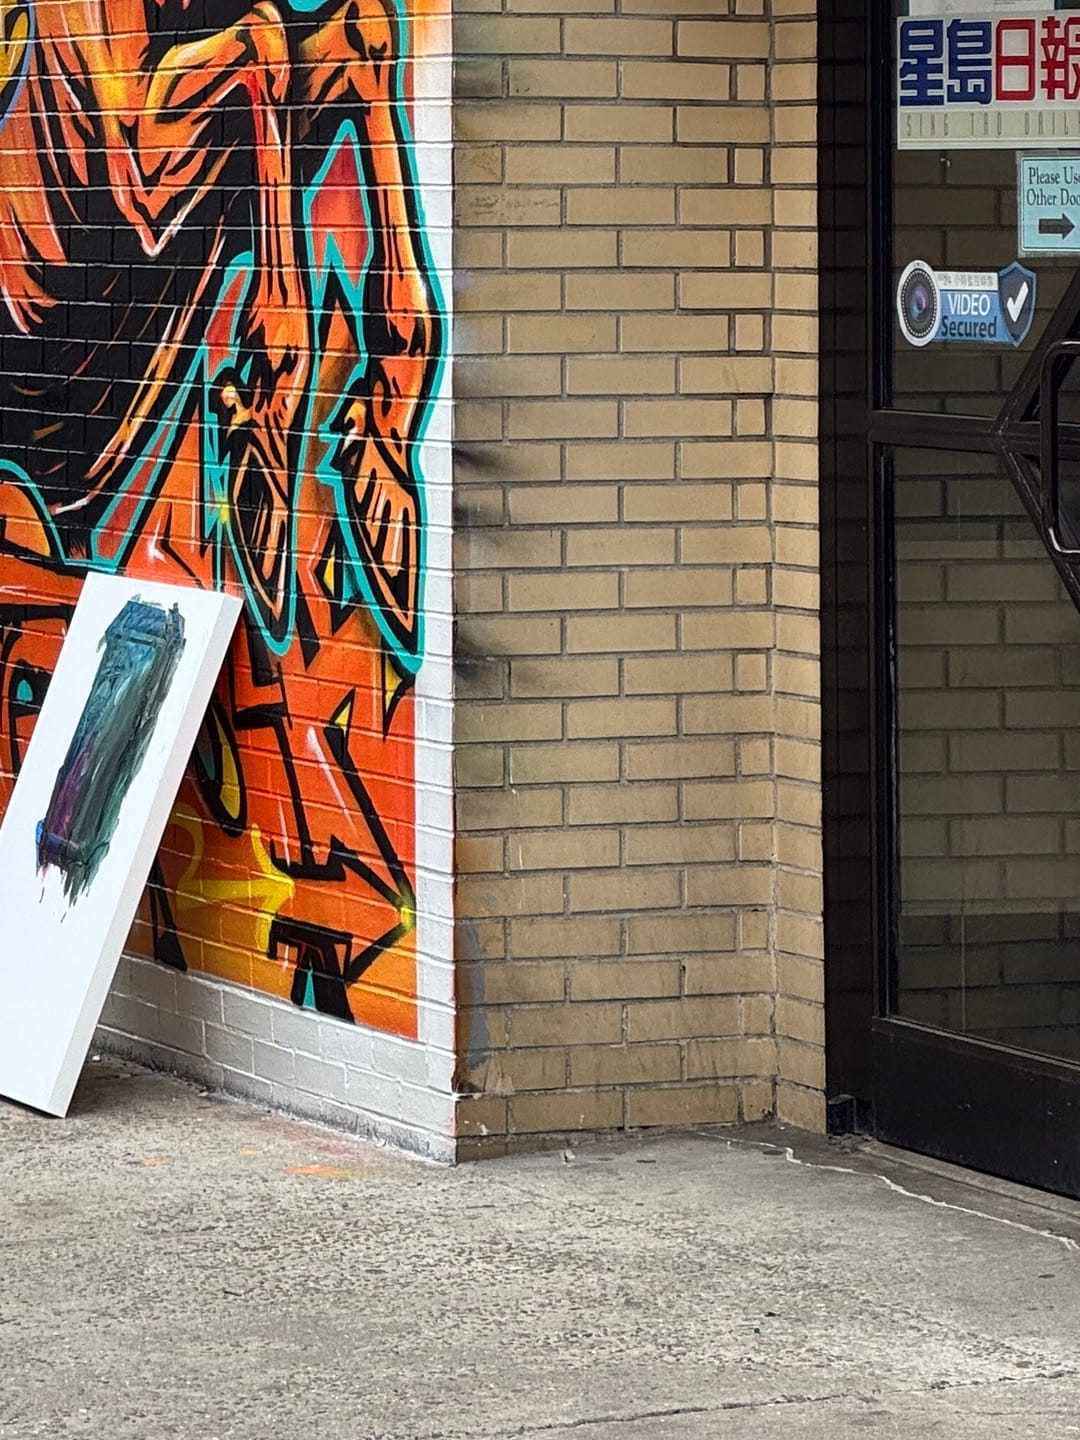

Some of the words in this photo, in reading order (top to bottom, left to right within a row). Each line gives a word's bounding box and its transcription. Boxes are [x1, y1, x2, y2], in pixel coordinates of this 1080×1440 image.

[906, 113, 949, 136] SING
[970, 112, 1002, 136] TAO
[1024, 111, 1080, 136] DAIL
[1028, 166, 1061, 185] Please
[1026, 188, 1057, 207] Other
[947, 293, 991, 317] VIDEO
[940, 316, 998, 339] Secured
